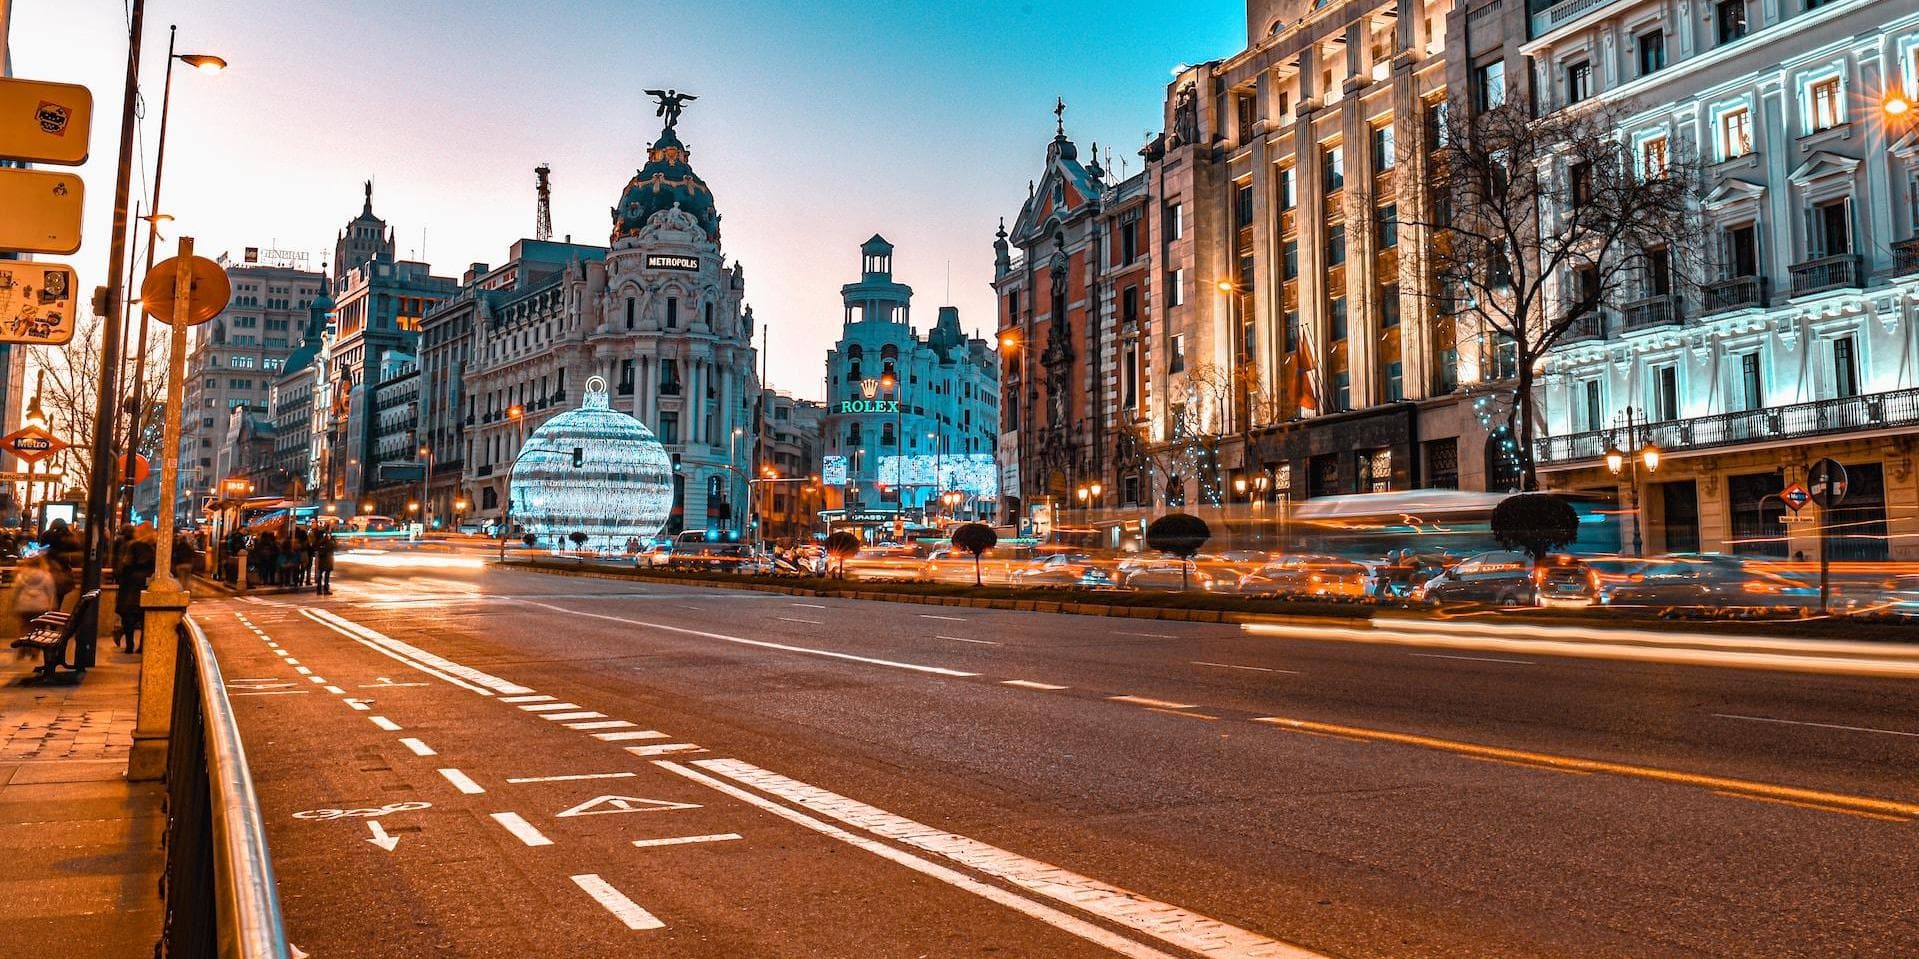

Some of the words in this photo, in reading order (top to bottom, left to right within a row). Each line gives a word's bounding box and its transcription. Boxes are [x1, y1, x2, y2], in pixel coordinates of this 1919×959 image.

[649, 257, 698, 269] METROPOLIS
[841, 400, 899, 413] ROLEX
[17, 438, 48, 449] Metro
[1022, 519, 1030, 531] P
